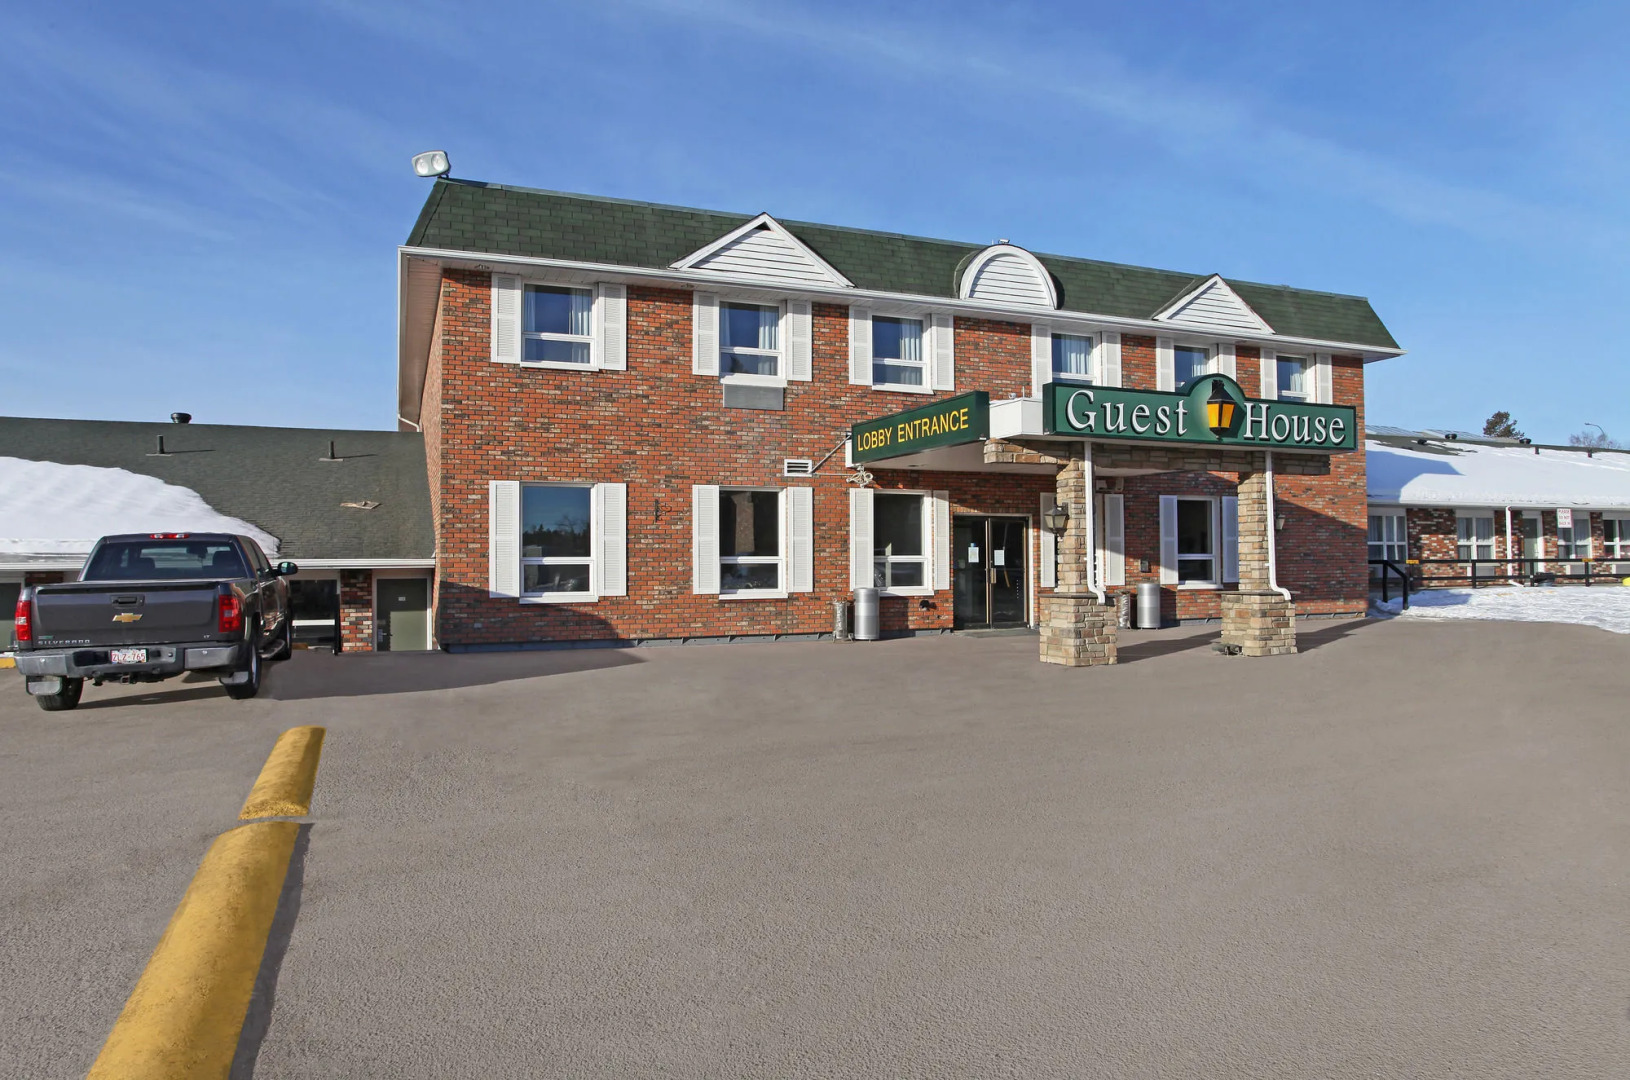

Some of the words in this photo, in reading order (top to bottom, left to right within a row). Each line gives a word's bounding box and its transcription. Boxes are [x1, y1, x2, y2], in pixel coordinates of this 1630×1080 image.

[857, 427, 893, 452] LOBBY
[897, 407, 969, 443] ENTRANCE
[1066, 389, 1188, 436] Guest
[1243, 402, 1346, 445] House
